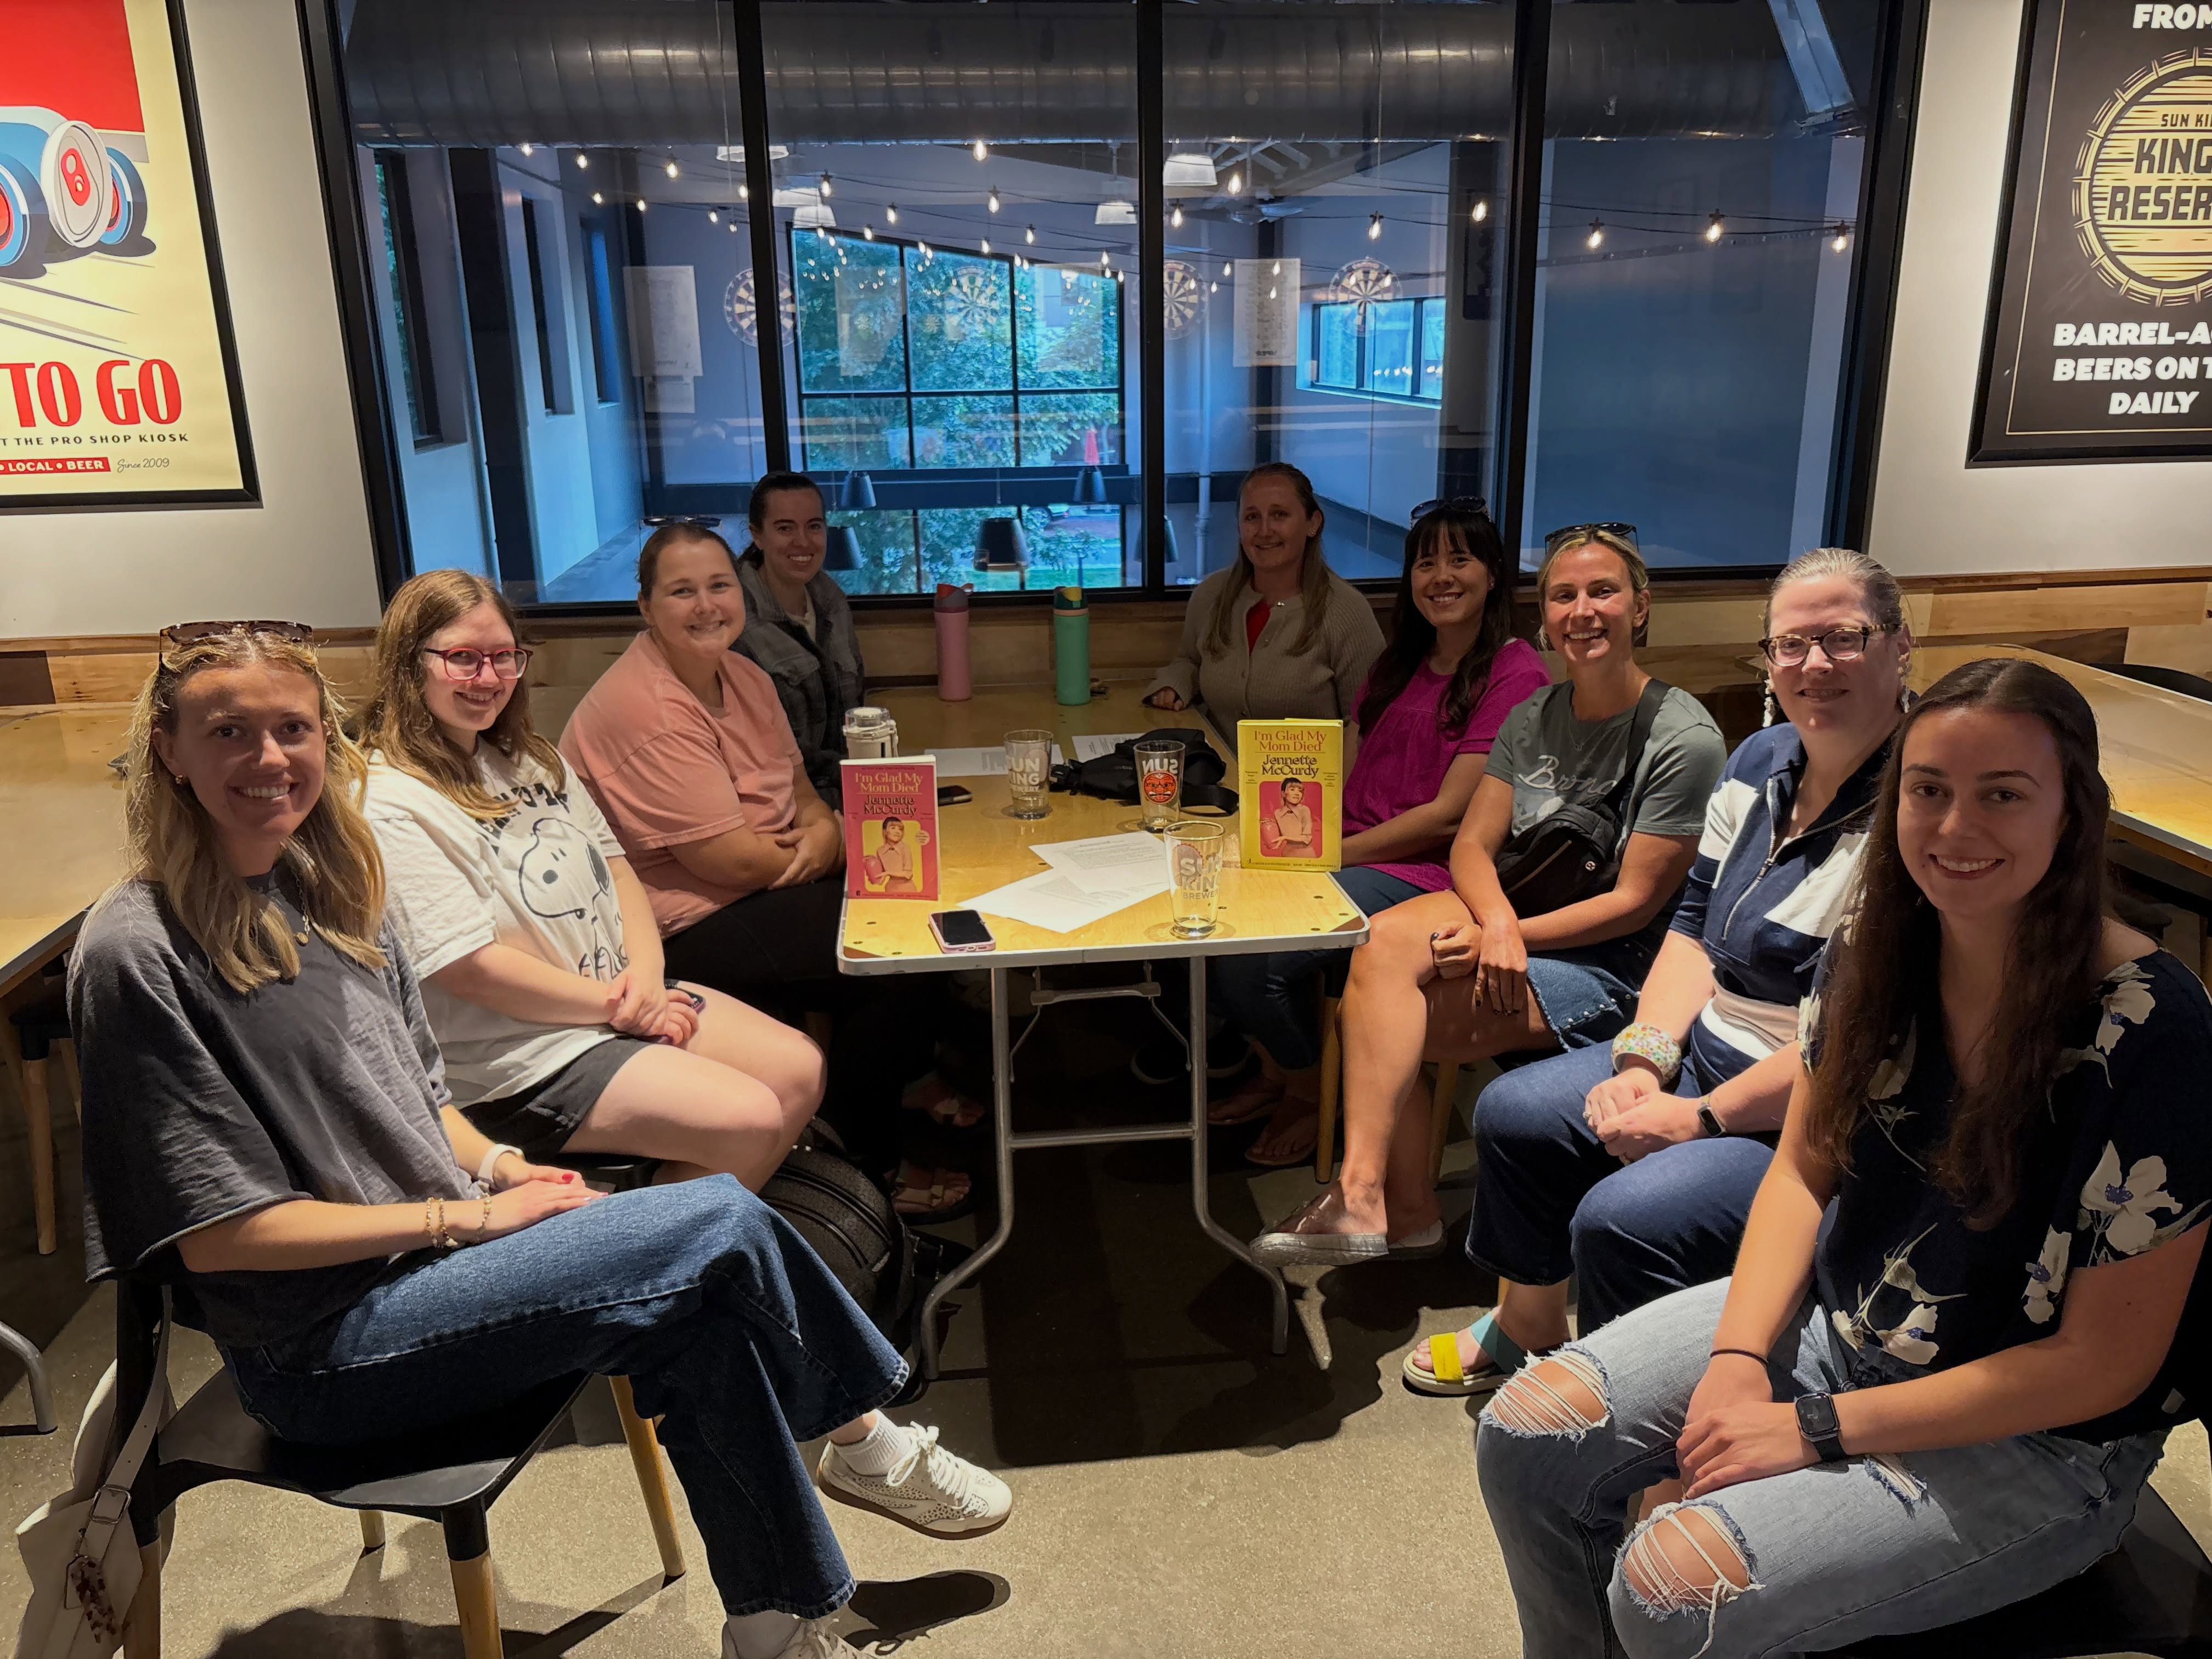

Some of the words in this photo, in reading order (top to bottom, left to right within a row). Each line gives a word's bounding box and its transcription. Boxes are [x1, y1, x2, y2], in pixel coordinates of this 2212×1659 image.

[2160, 114, 2190, 127] SUN
[2194, 114, 2212, 127] KI
[2053, 321, 2212, 346] BARREL-A
[2053, 357, 2153, 381] BEERS
[2155, 356, 2199, 380] ON
[0, 361, 82, 427] TO
[96, 359, 182, 425] GO
[2108, 391, 2200, 414] DAILY
[14, 437, 44, 445] THE
[51, 436, 82, 445] PRO
[89, 435, 132, 444] SHOP
[139, 433, 189, 442] KIOSK
[8, 461, 54, 472] LOCAL
[65, 460, 105, 470] BEER
[117, 458, 141, 473] Since
[143, 458, 170, 468] 2009
[1254, 730, 1273, 741] I'm
[1276, 730, 1304, 741] Glad
[1307, 730, 1327, 744] My
[1259, 741, 1290, 751] Mom
[1293, 741, 1322, 751] Died
[1263, 754, 1318, 765] Jennette
[1262, 765, 1319, 778] McCurdy
[1518, 754, 1618, 795] Bronc
[855, 772, 872, 783] I'm
[875, 772, 902, 783] Glad
[905, 772, 923, 786] My
[1009, 771, 1040, 786] ING
[860, 783, 889, 793] Mom
[893, 783, 918, 793] Died
[865, 795, 915, 805] Jennette
[864, 804, 917, 817] McCurdy
